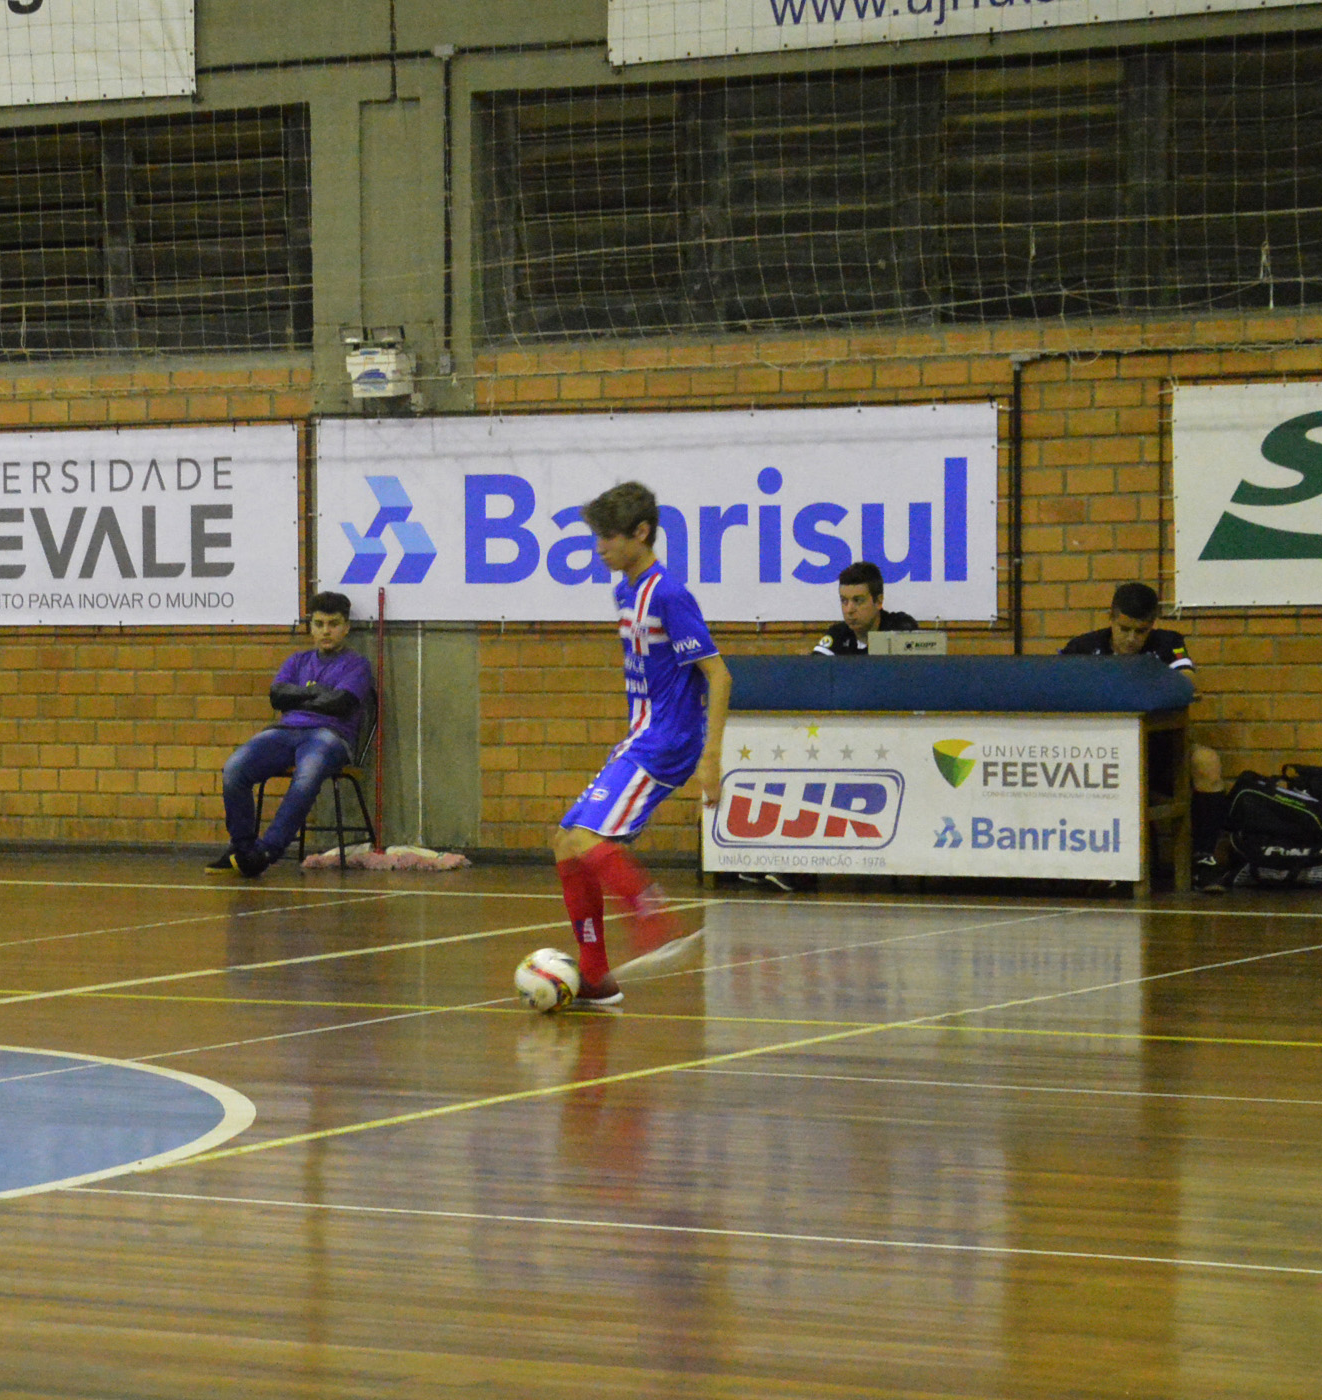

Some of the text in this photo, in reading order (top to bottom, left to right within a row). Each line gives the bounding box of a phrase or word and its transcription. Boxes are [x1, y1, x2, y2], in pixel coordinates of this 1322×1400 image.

[28, 593, 75, 609] PARA
[78, 593, 144, 609] INOVAR
[148, 592, 162, 609] O
[166, 592, 234, 609] MUNDO
[982, 745, 1119, 760] UNIVERSIDADE
[982, 761, 1120, 789] FEEVALE
[726, 783, 888, 839] UJR
[971, 816, 1121, 853] Banrisul
[754, 855, 790, 867] JOVEM
[792, 856, 809, 867] DO
[862, 857, 887, 868] 1978
